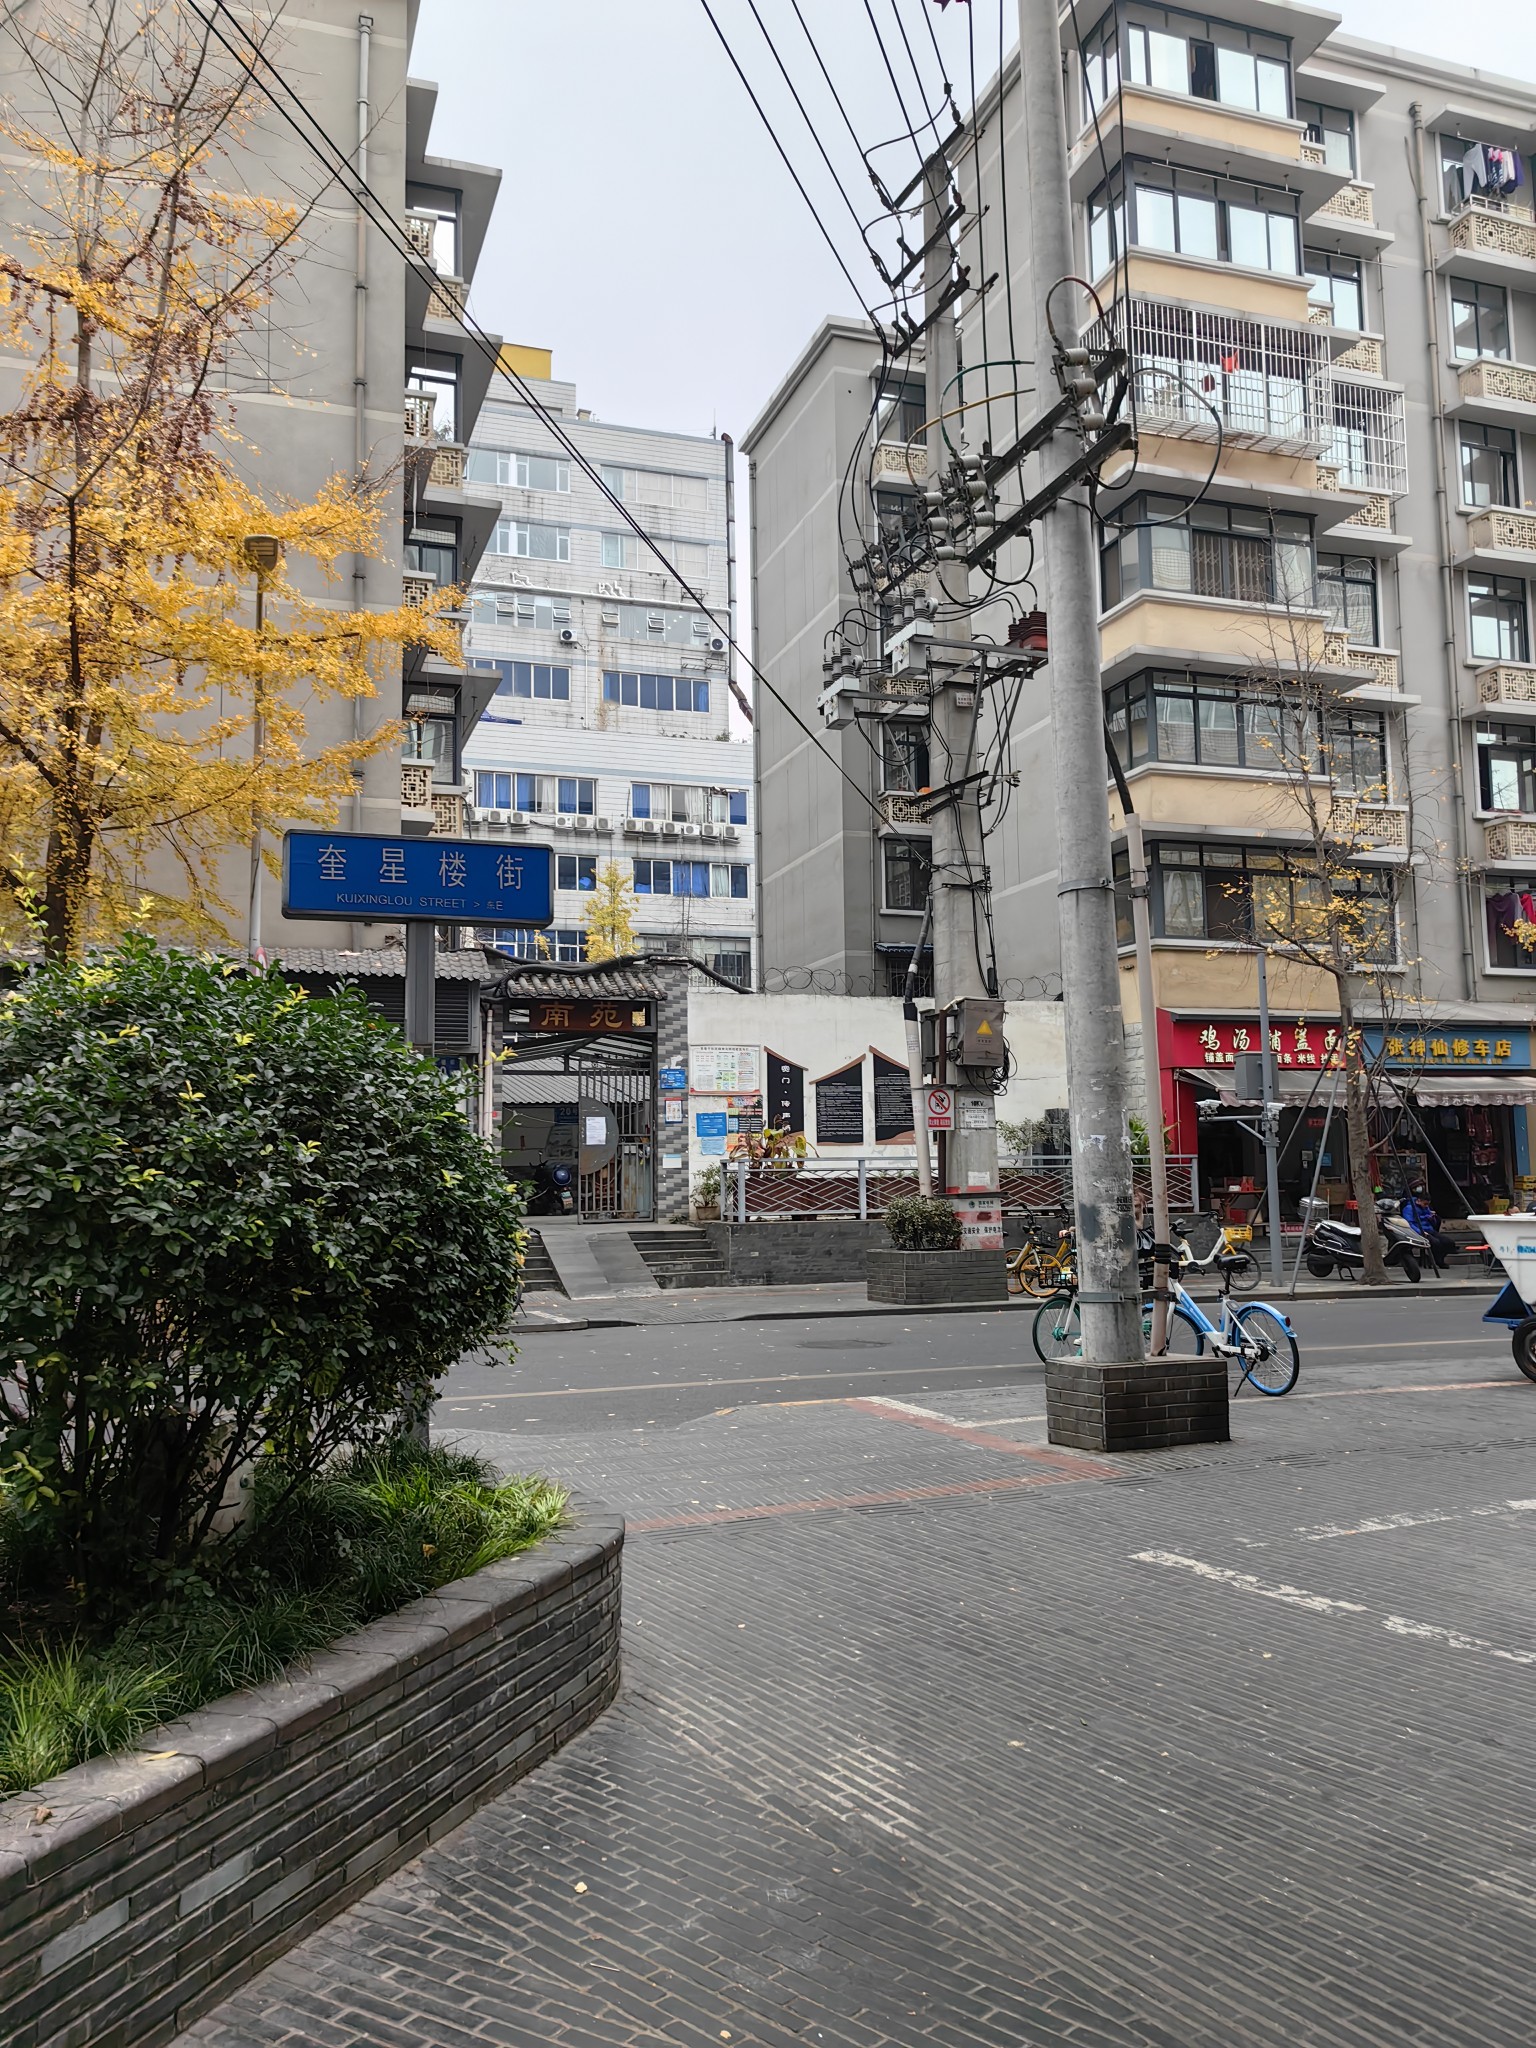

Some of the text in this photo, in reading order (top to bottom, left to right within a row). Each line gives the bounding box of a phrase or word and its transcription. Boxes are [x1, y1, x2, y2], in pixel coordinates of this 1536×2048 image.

[318, 843, 524, 890] 奎星楼街
[336, 893, 413, 906] KUIXINGLOU
[419, 896, 466, 909] STREET
[540, 1001, 623, 1028] 南苑
[1388, 1036, 1512, 1057] 张神仙修车店
[1297, 1053, 1316, 1064] 米线
